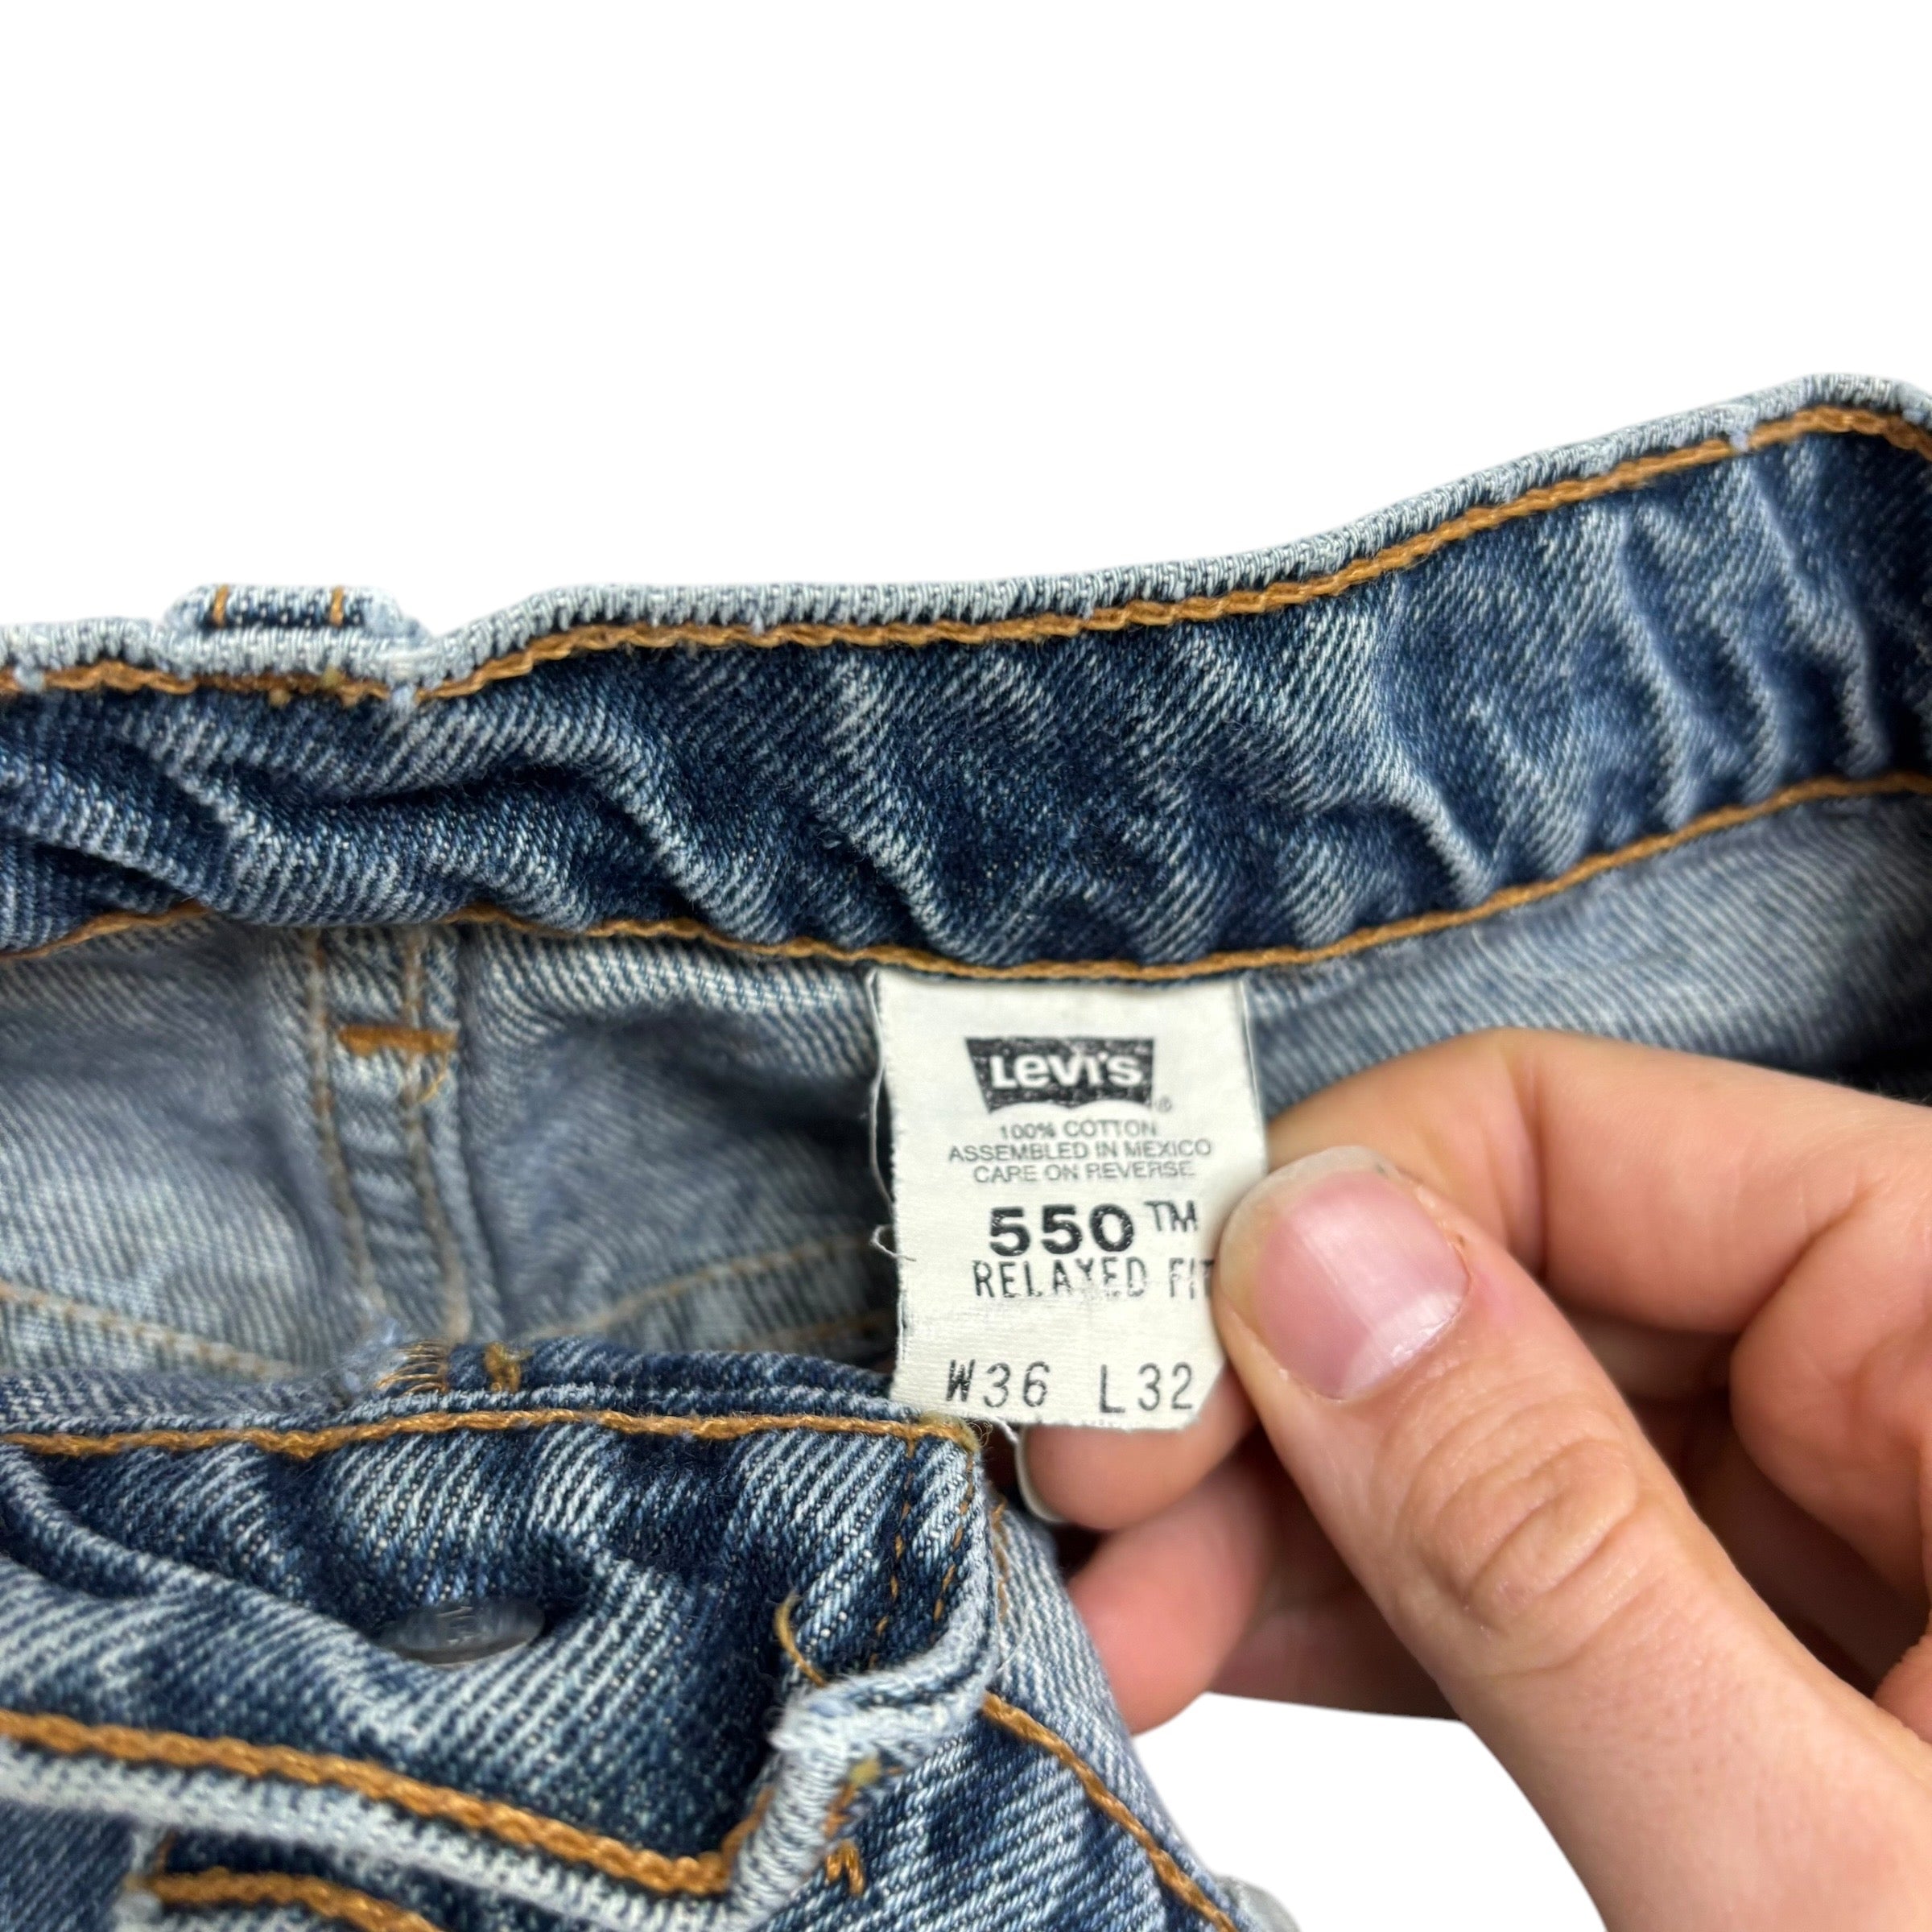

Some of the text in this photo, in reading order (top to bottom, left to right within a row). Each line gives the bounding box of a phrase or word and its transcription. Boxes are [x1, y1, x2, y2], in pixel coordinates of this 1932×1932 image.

[1000, 1118, 1157, 1140] 100% COTTON
[948, 1138, 1212, 1162] ASSEMBLED IN MEXICO
[973, 1160, 1195, 1183] CARE ON REVERSE
[989, 1203, 1135, 1257] 550
[945, 1358, 1194, 1414] W36 L32
